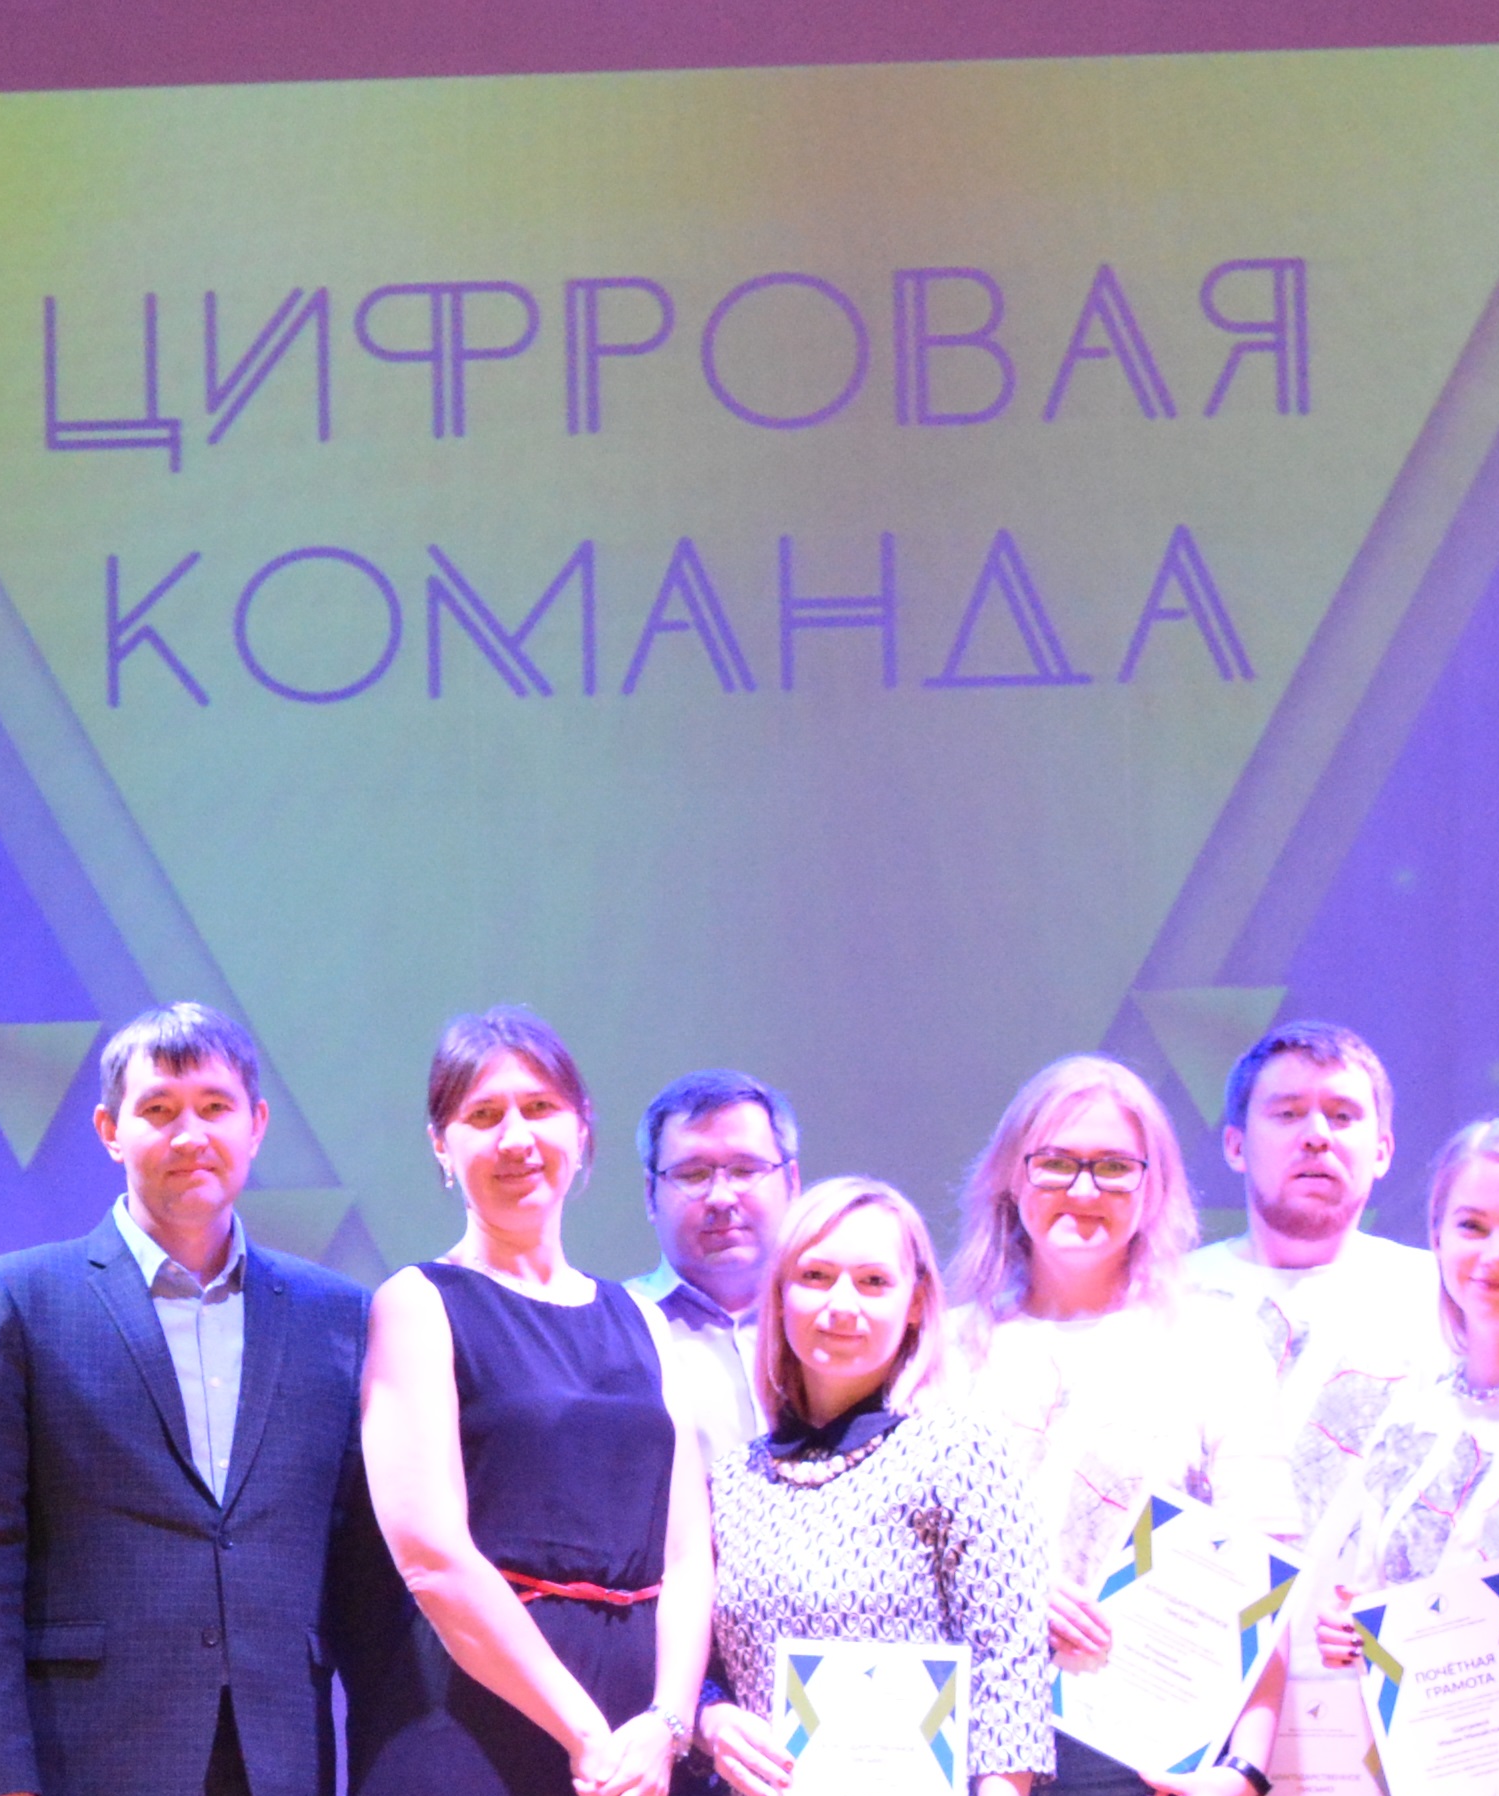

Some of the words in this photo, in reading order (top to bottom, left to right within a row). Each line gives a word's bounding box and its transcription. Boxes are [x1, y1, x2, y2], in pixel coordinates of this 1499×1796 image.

[42, 256, 1312, 474] ЦИФРОВАЯ
[104, 522, 1257, 708] КОМАНДА
[1414, 1652, 1497, 1684] ПОЧЁТНАЯ
[1425, 1672, 1497, 1699] ГРАМОТА
